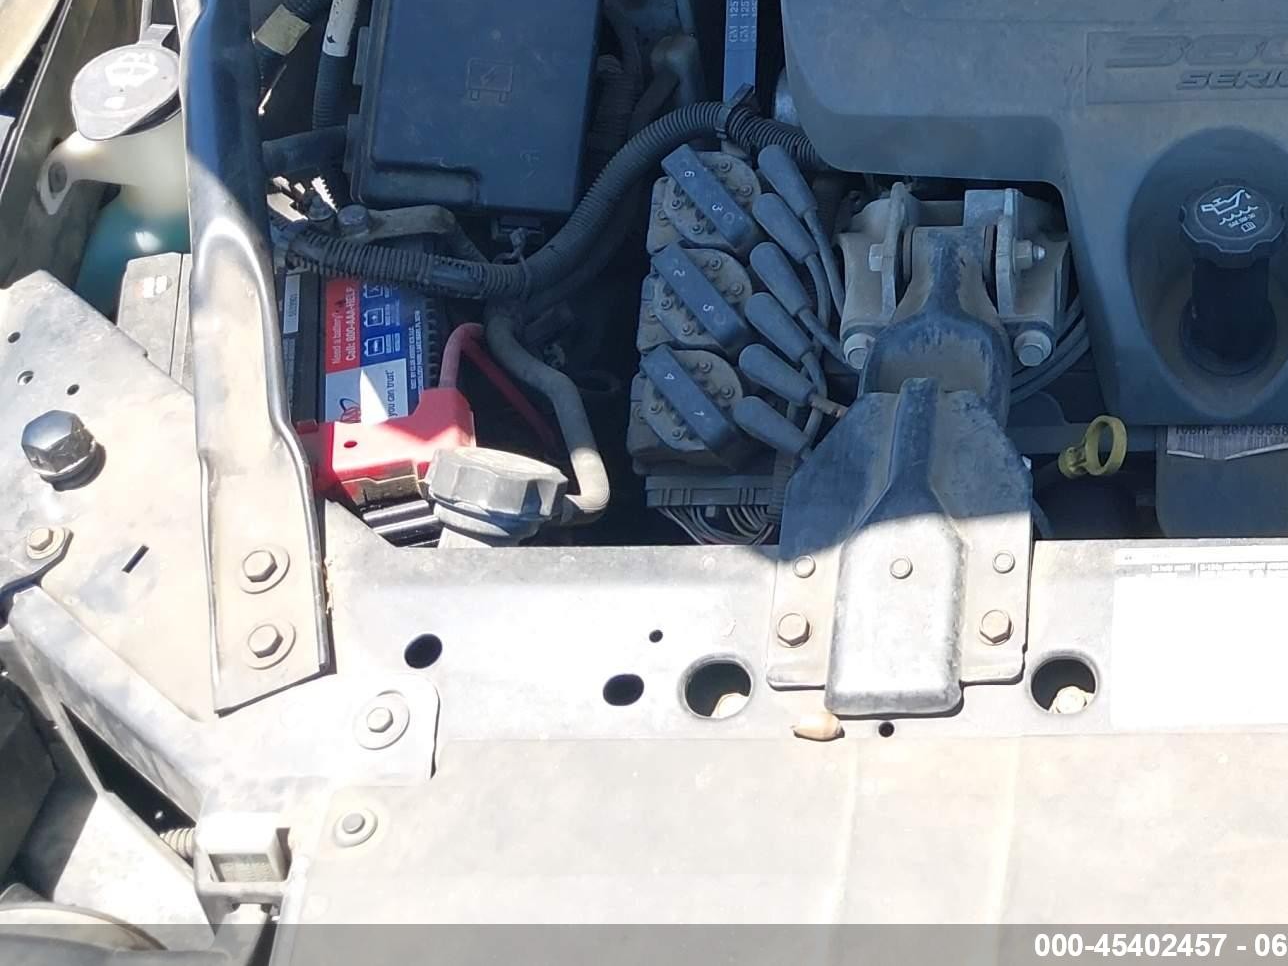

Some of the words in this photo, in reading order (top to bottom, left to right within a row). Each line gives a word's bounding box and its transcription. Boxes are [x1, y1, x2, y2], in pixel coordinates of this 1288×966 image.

[729, 25, 739, 43] GM
[711, 201, 724, 213] 3
[672, 269, 687, 278] 2
[702, 303, 715, 313] 5
[345, 342, 356, 362] Call:
[386, 371, 396, 388] trust
[663, 371, 676, 382] 4
[386, 389, 396, 403] can
[386, 403, 399, 418] you
